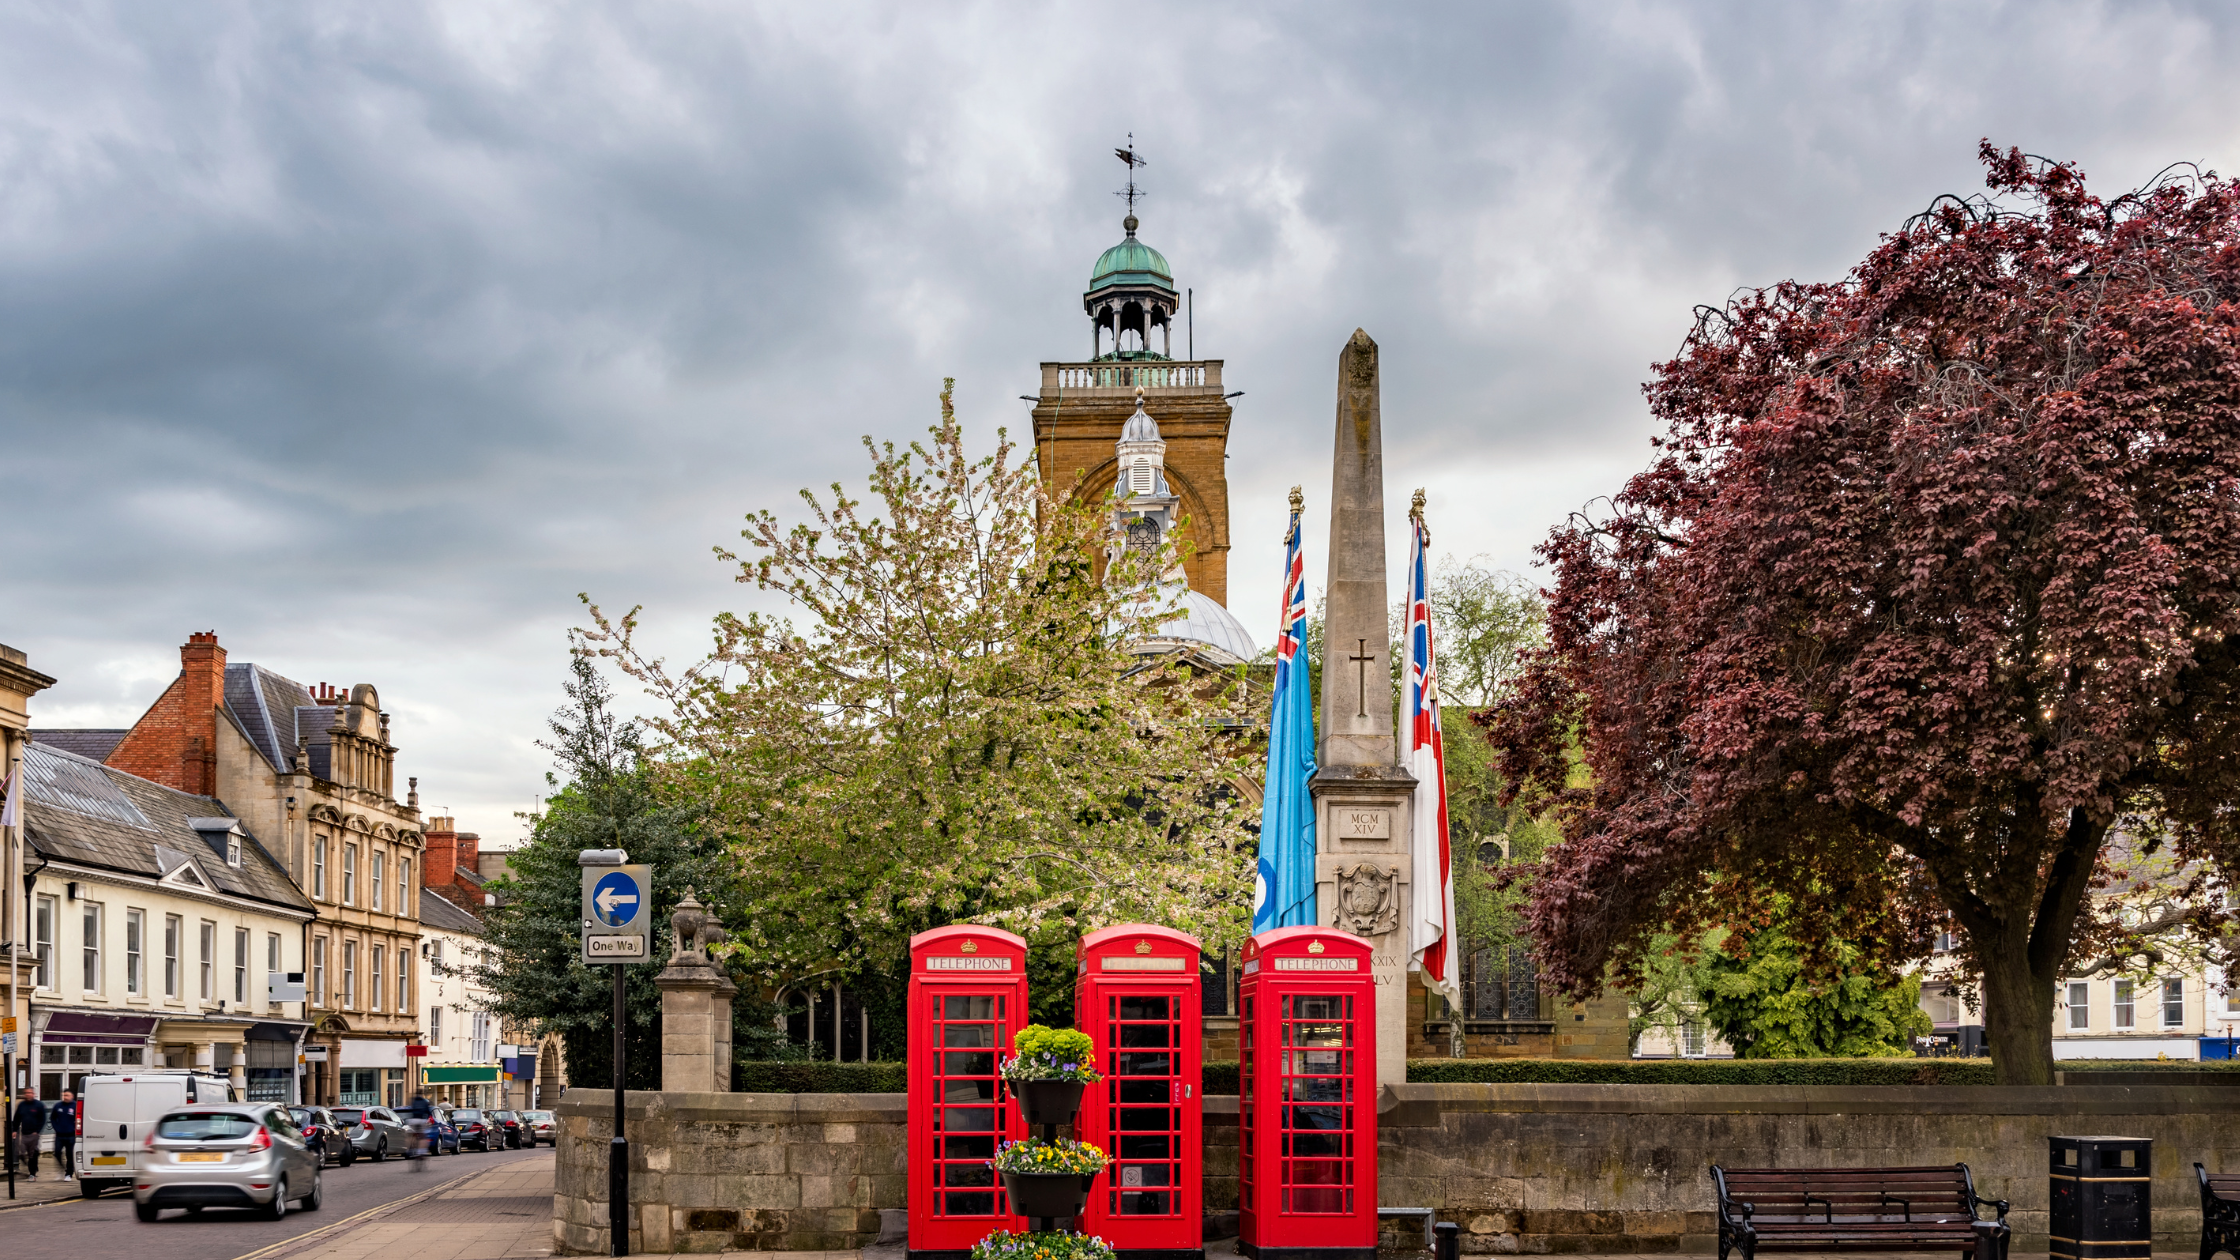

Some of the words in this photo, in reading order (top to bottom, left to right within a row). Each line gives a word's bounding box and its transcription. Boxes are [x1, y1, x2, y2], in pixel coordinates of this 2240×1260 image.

[1351, 814, 1378, 824] MCM
[1353, 825, 1376, 834] XIV
[592, 941, 613, 951] One
[617, 940, 639, 952] Way
[930, 957, 1008, 969] TELEPHONE
[1279, 959, 1355, 970] TELEPHONE
